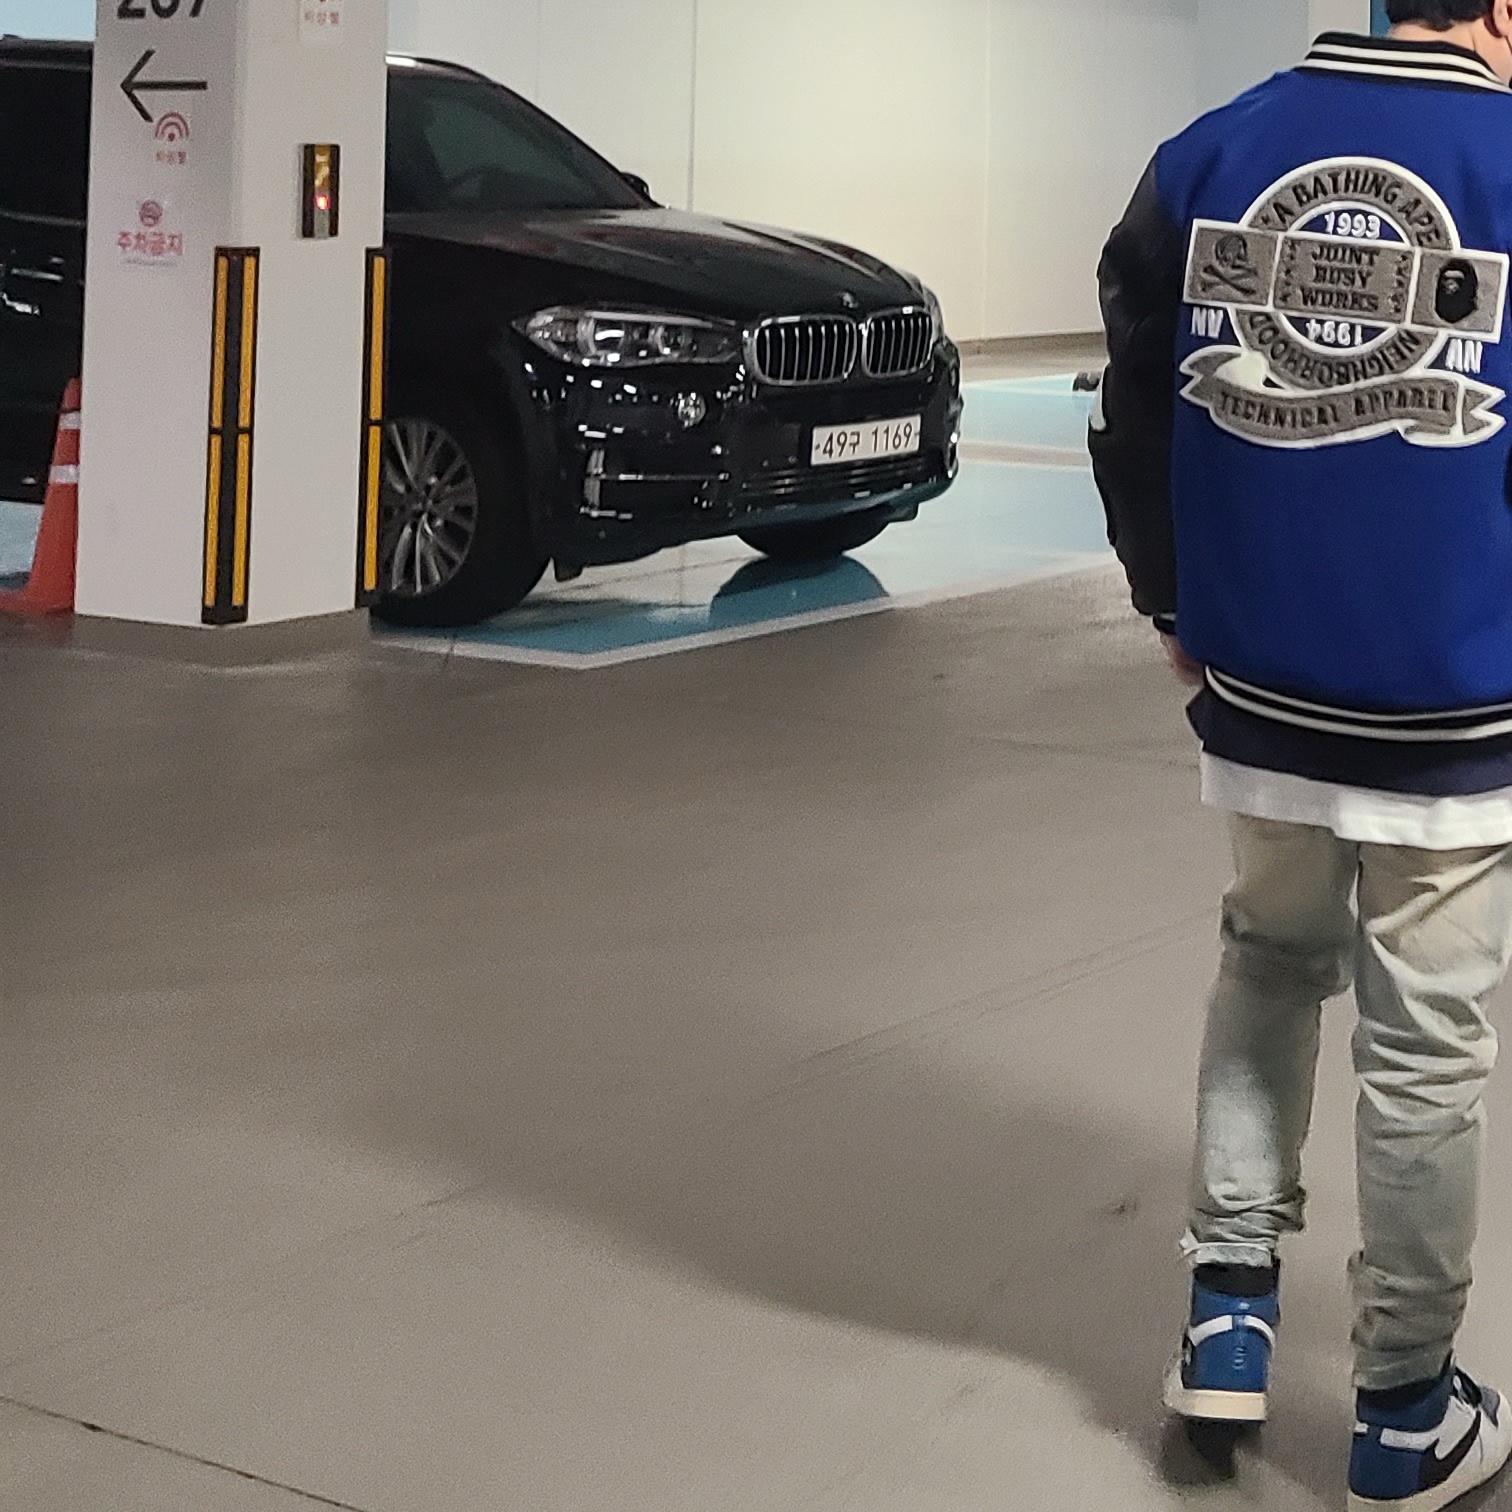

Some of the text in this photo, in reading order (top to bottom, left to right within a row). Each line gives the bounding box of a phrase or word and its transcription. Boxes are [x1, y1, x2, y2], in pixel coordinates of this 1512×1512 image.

[1273, 169, 1440, 246] A BATHING APE
[1324, 211, 1381, 238] 1993
[1312, 245, 1380, 266] JOINT
[1313, 266, 1373, 288] BUSY
[1300, 287, 1379, 311] WORKS
[1306, 318, 1362, 346] 1994
[1249, 312, 1421, 387] NEIGHBORHOOD
[1221, 387, 1451, 429] TECHNICAL APPAREL
[822, 422, 913, 459] 49구 1169
